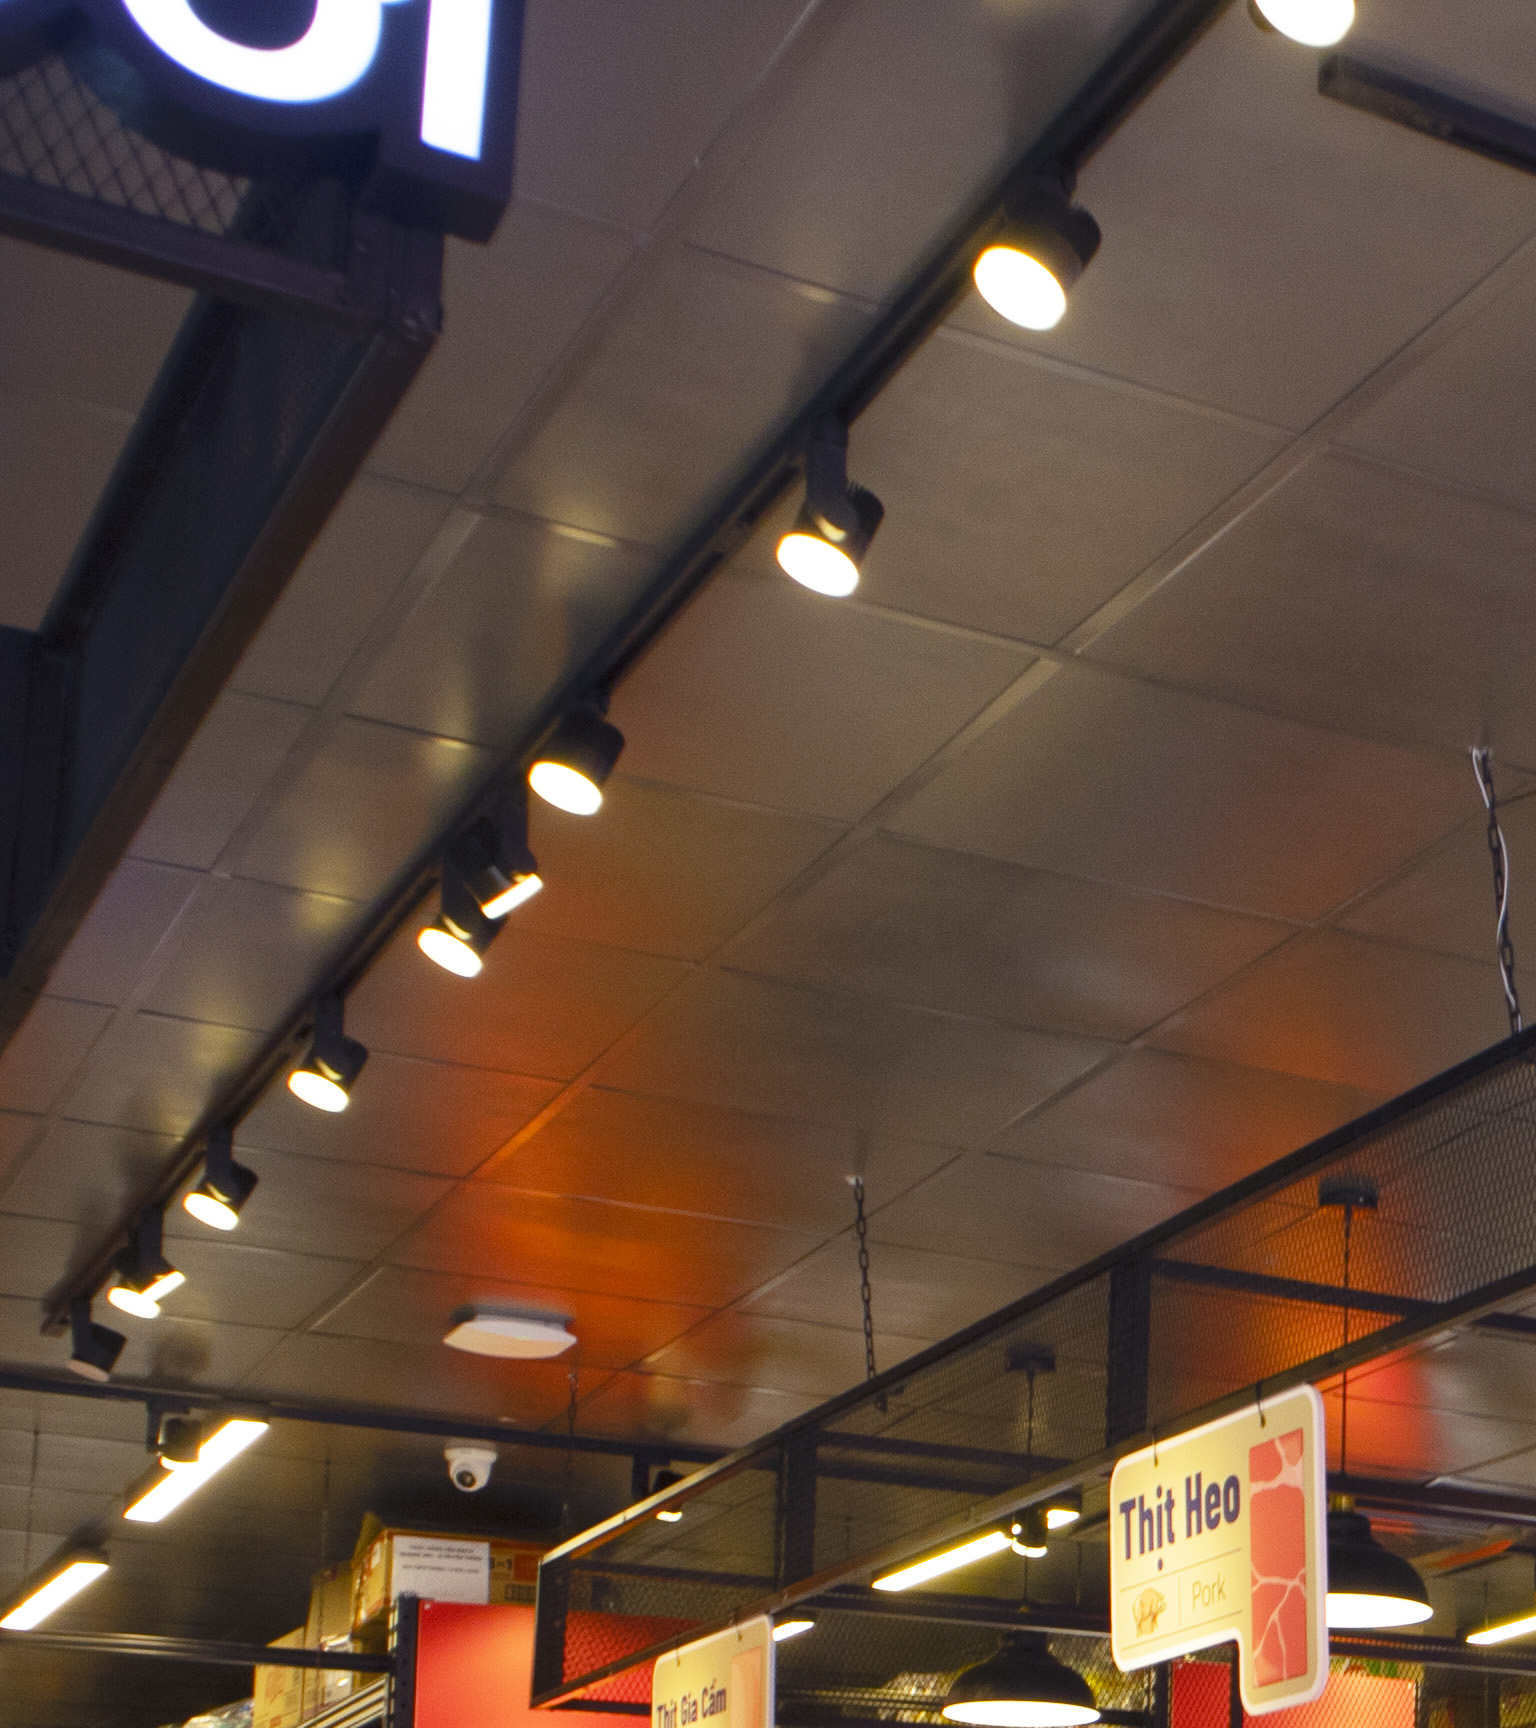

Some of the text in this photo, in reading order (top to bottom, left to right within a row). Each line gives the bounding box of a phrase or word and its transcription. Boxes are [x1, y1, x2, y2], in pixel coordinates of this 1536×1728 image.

[1119, 1471, 1241, 1571] Thịt Heo
[1192, 1571, 1226, 1611] Pork
[681, 1694, 697, 1726] Gia
